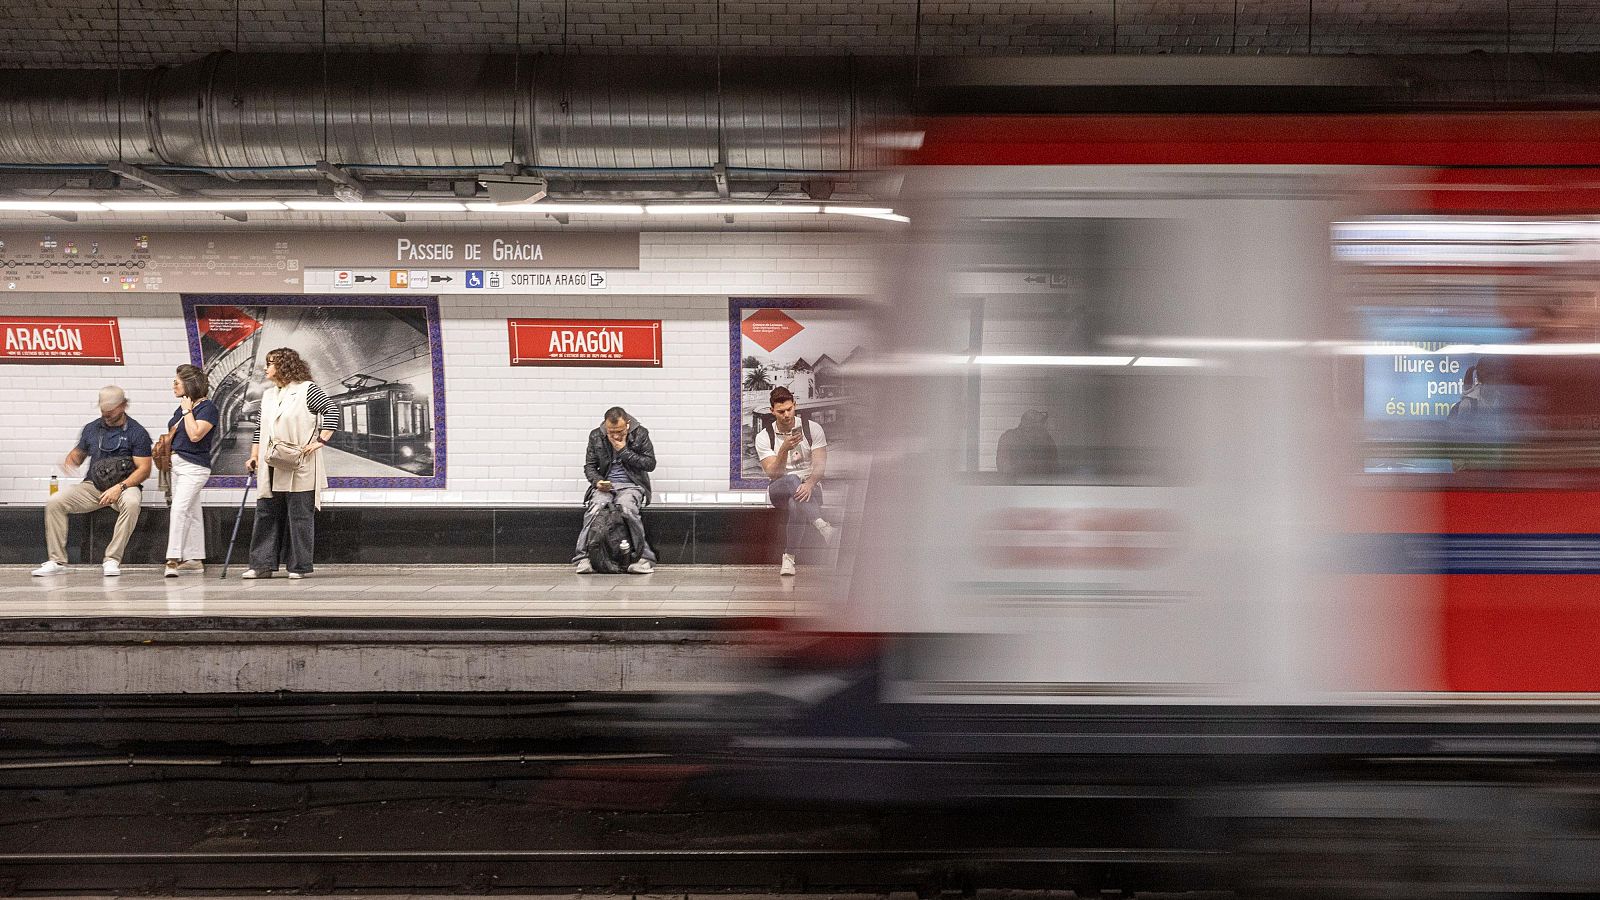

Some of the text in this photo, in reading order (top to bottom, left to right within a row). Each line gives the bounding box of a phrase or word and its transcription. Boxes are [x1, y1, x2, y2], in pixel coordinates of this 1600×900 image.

[397, 238, 544, 261] PASSEIG DE GRÀCIA
[511, 271, 587, 286] SORTIDA ARAGÓ
[5, 324, 83, 351] ARAGÓN
[548, 327, 624, 353] ARAGÓN
[1394, 355, 1460, 373] lliure de
[1385, 397, 1406, 416] és
[1410, 401, 1430, 416] un
